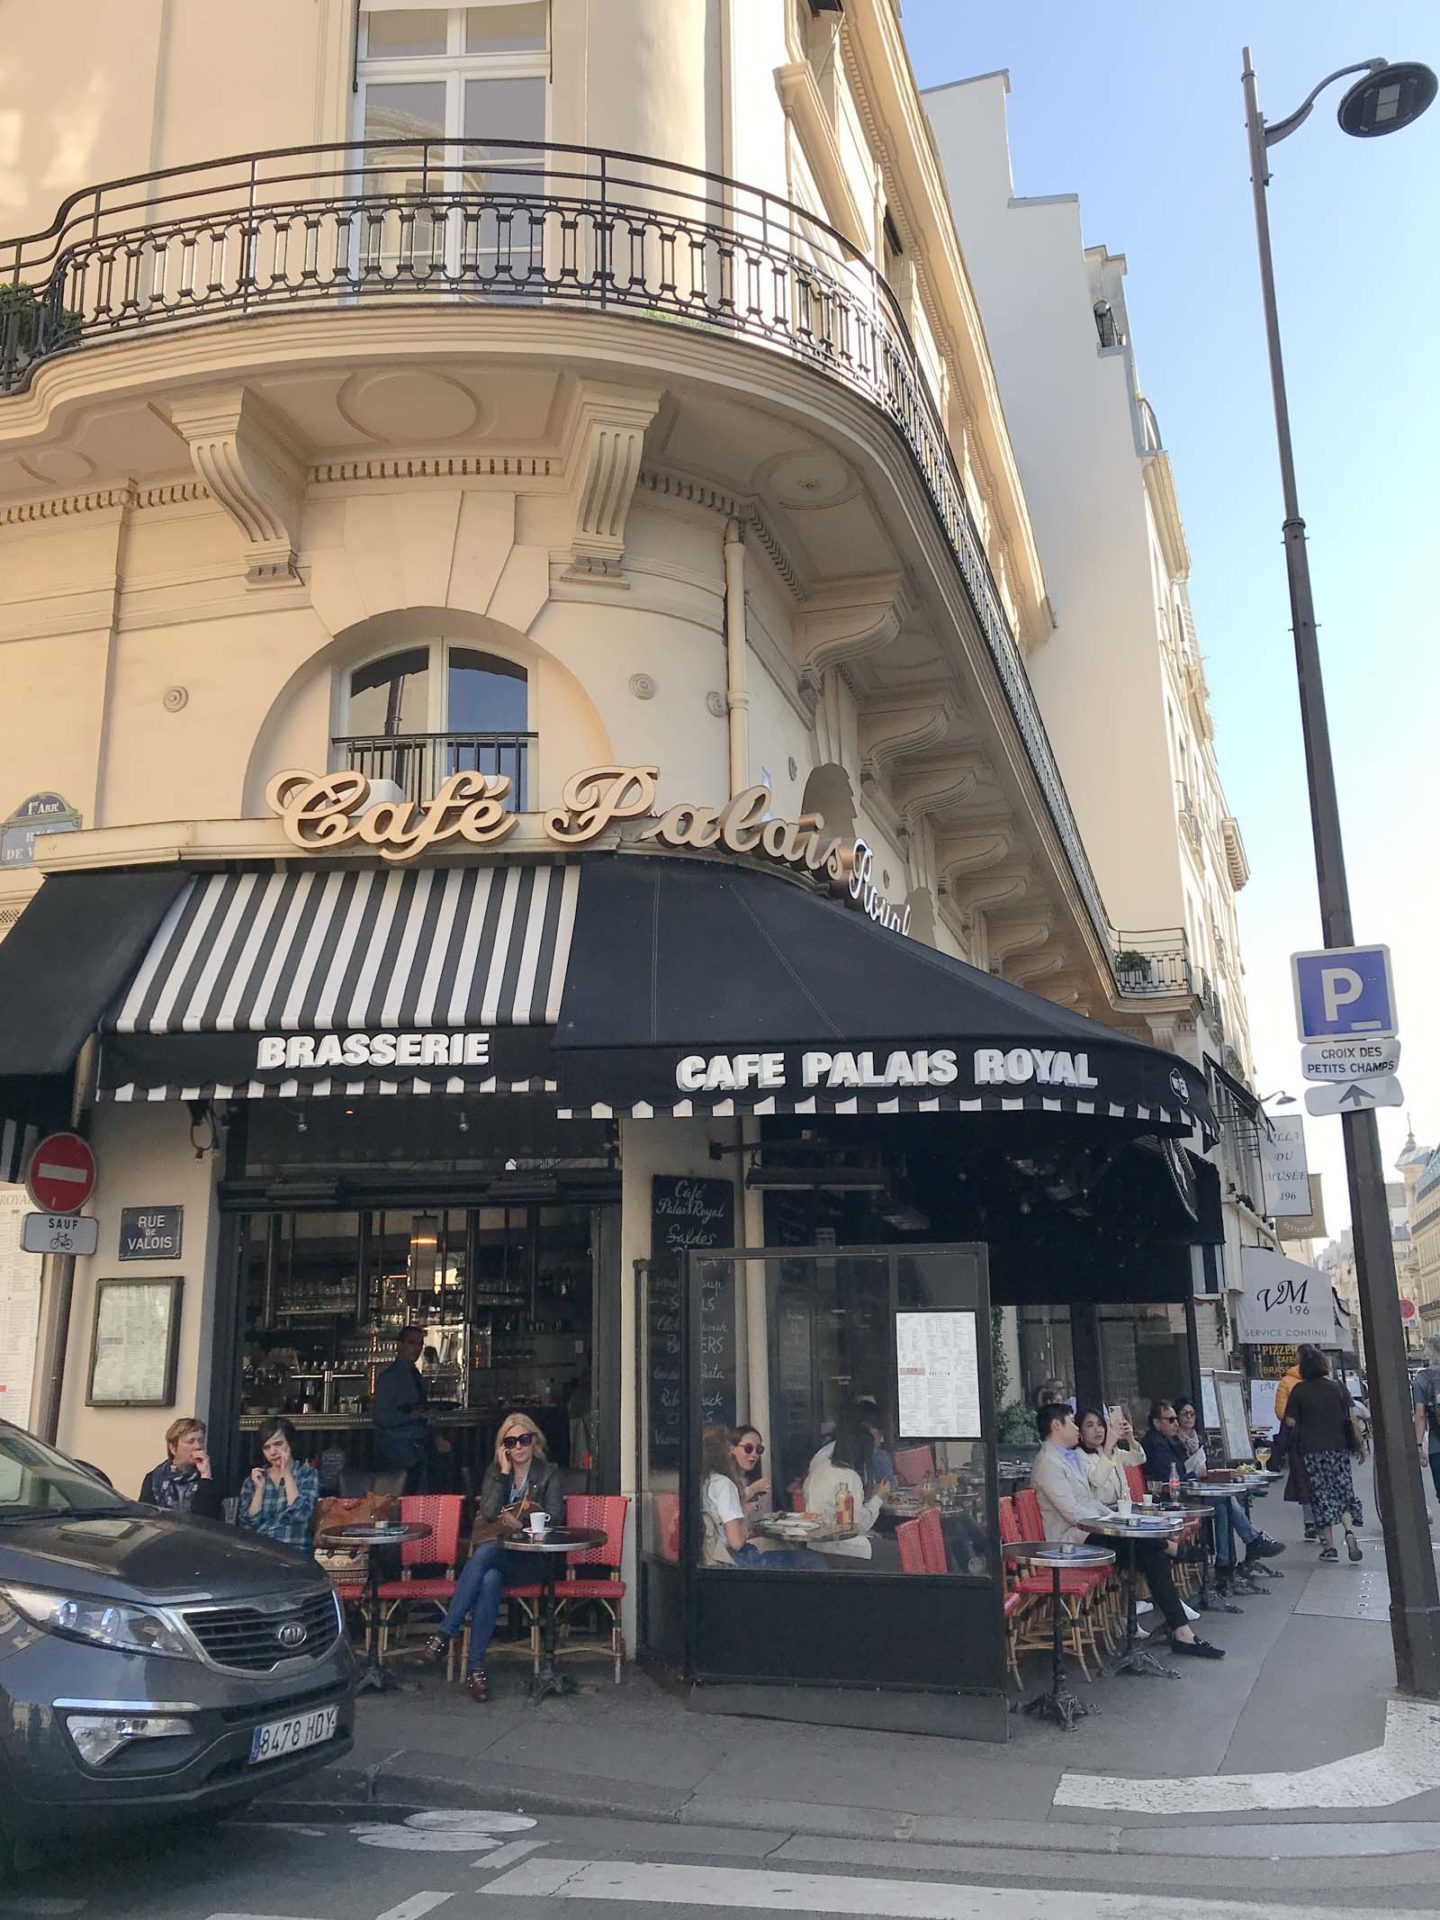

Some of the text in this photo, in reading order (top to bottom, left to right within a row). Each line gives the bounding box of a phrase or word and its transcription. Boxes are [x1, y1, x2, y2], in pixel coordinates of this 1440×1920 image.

[265, 768, 520, 862] Café
[543, 765, 846, 882] Palais
[1321, 967, 1364, 1022] P
[257, 1032, 490, 1069] BRASSERIE
[1321, 1046, 1383, 1059] CROIX DES
[676, 1047, 1099, 1090] CAFE PALAIS ROYAL
[1307, 1060, 1395, 1074] PETITS CHAMPS
[1275, 1151, 1295, 1162] DU
[1280, 1191, 1297, 1202] 196
[48, 1217, 79, 1230] SAUF
[138, 1215, 166, 1228] RUE
[127, 1236, 173, 1251] VALOIS
[1288, 1305, 1310, 1316] 196
[1244, 1328, 1328, 1338] SERVICE CONTINU
[261, 1711, 334, 1755] 8478 HDY
